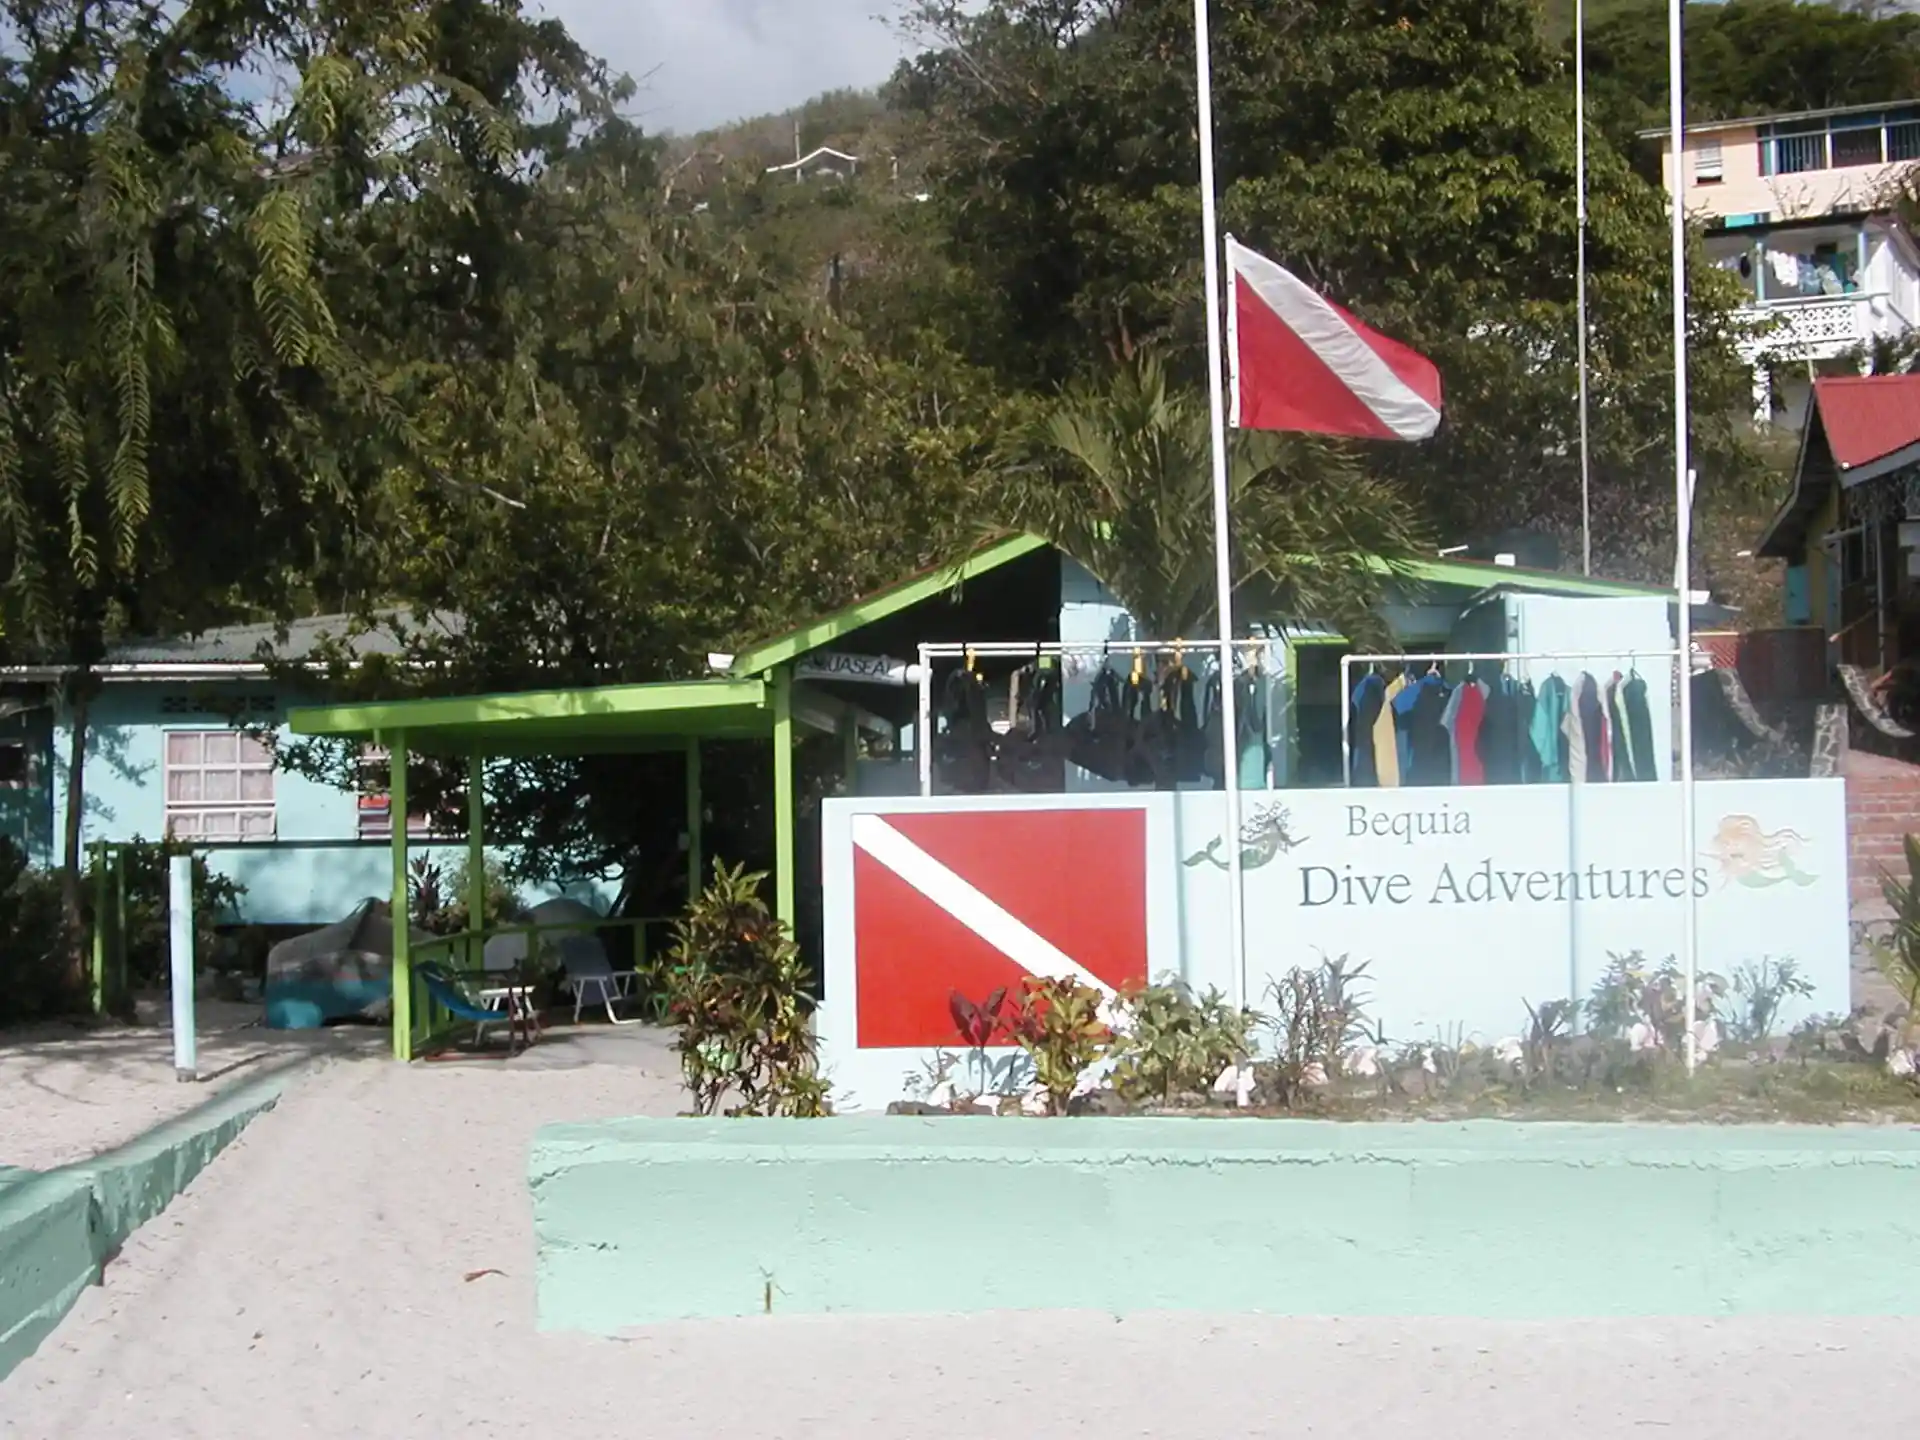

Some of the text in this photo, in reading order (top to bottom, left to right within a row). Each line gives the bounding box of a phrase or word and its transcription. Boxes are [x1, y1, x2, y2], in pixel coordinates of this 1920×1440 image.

[1345, 803, 1470, 845] Bequia
[1298, 857, 1709, 906] Dive Adventures
